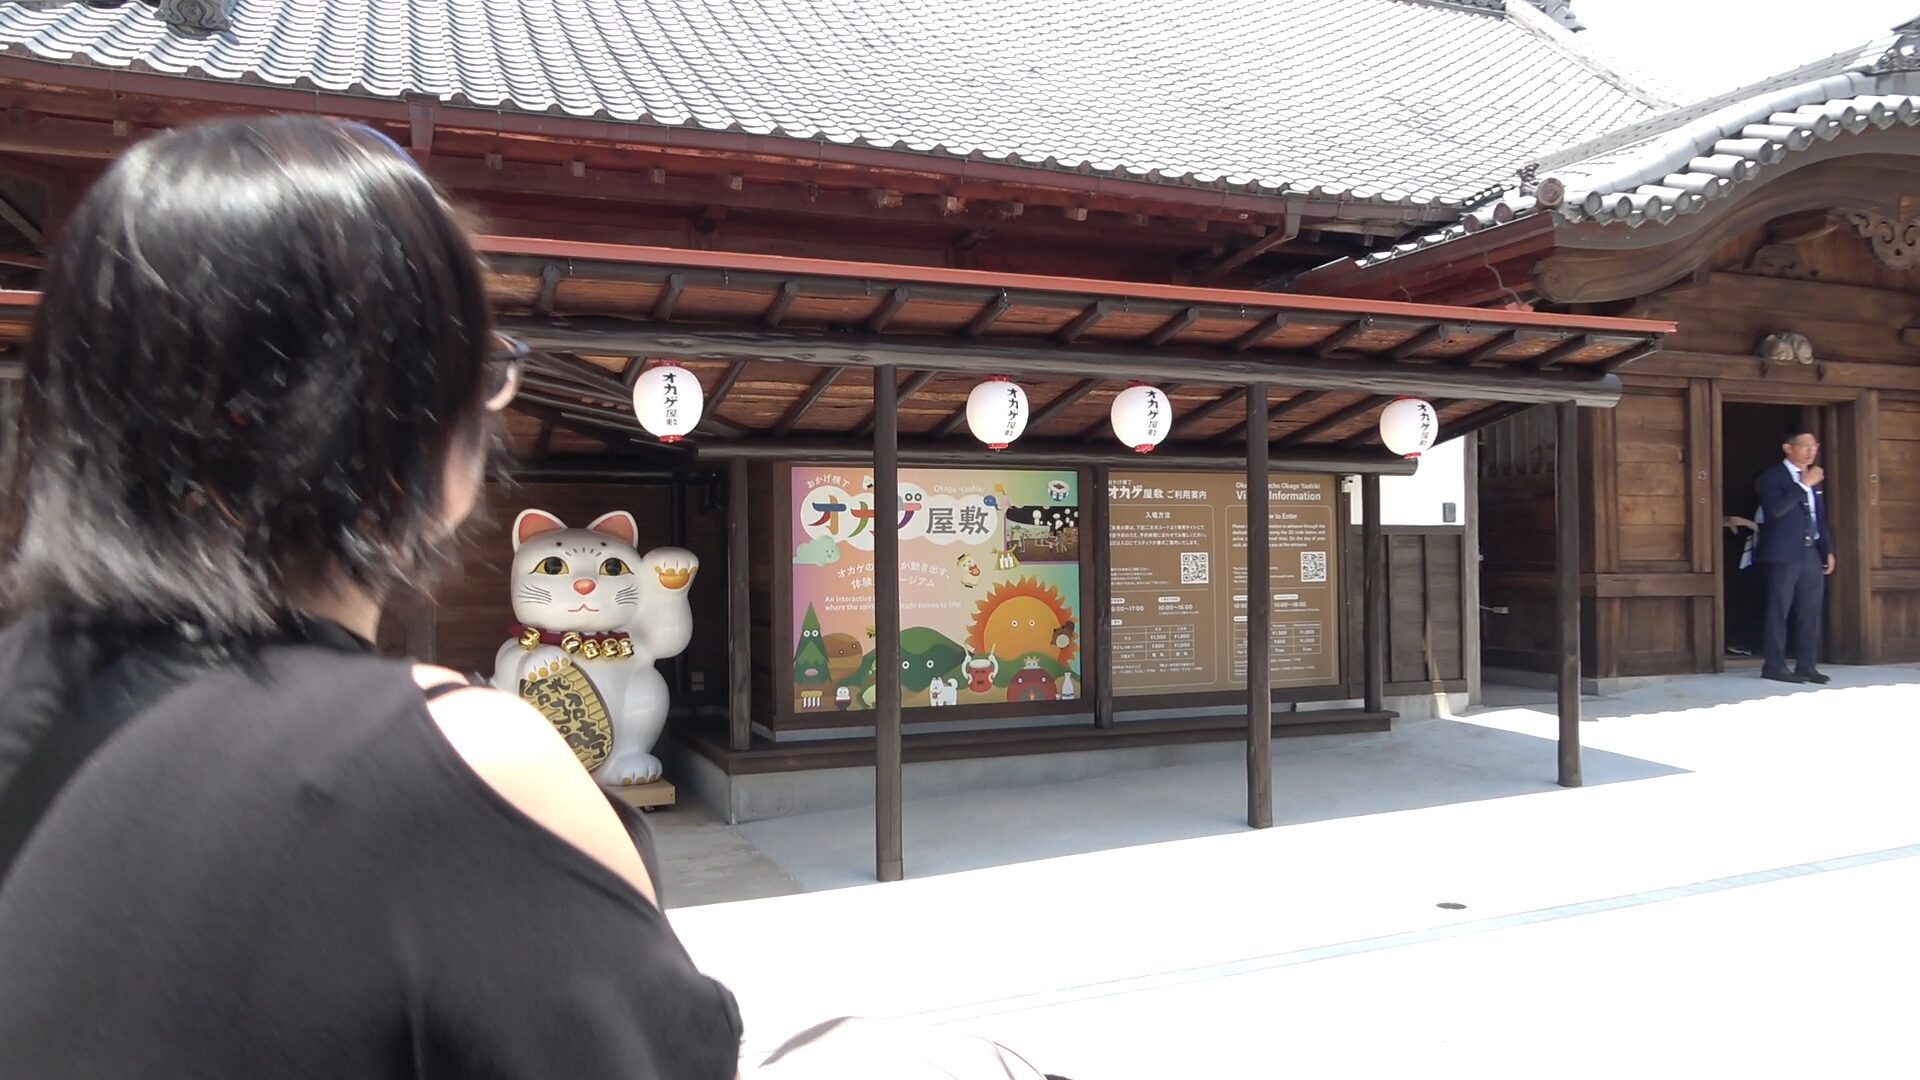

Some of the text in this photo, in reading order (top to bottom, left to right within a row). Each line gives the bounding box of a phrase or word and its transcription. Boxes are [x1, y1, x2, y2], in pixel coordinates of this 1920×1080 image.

[663, 373, 678, 426] オカゲ屋敷
[1004, 388, 1019, 437] オカゲ屋敷
[1145, 390, 1159, 436] オカゲ屋敷
[1108, 485, 1207, 499] オカゲ屋敷 ご利用案内
[1268, 490, 1321, 501] Information
